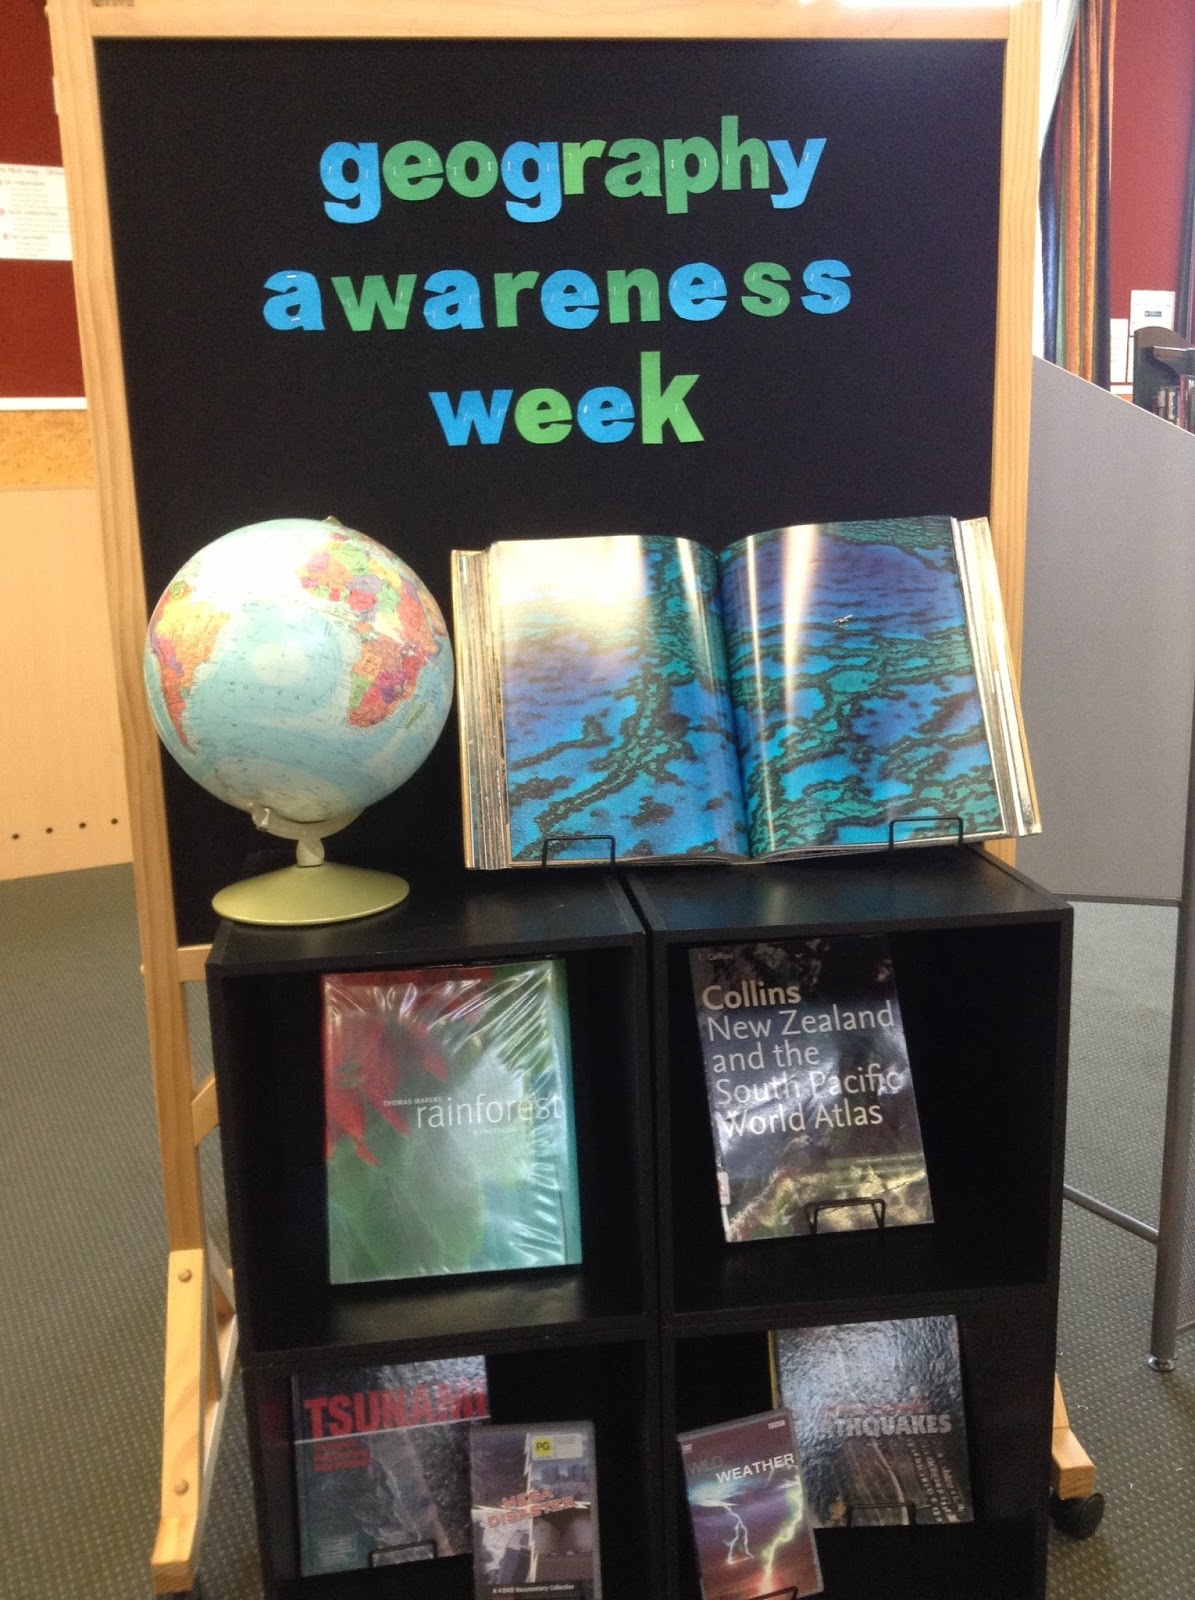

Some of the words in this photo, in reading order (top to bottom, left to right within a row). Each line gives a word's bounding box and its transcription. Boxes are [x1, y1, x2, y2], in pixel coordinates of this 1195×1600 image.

[320, 115, 827, 224] geography
[263, 259, 851, 332] awareness
[428, 351, 704, 446] week
[702, 980, 802, 1010] Collins
[707, 1015, 772, 1042] New
[779, 1000, 895, 1037] Zealand
[713, 1042, 765, 1074] and
[772, 1039, 820, 1069] the
[716, 1072, 801, 1106] South
[810, 1063, 904, 1096] Pacific
[416, 1093, 564, 1129] rainforest
[716, 1103, 806, 1138] World
[815, 1098, 883, 1130] Atlas
[303, 1377, 488, 1441] TSUNAMI
[536, 1441, 551, 1451] PG
[716, 1453, 795, 1483] WEATHER
